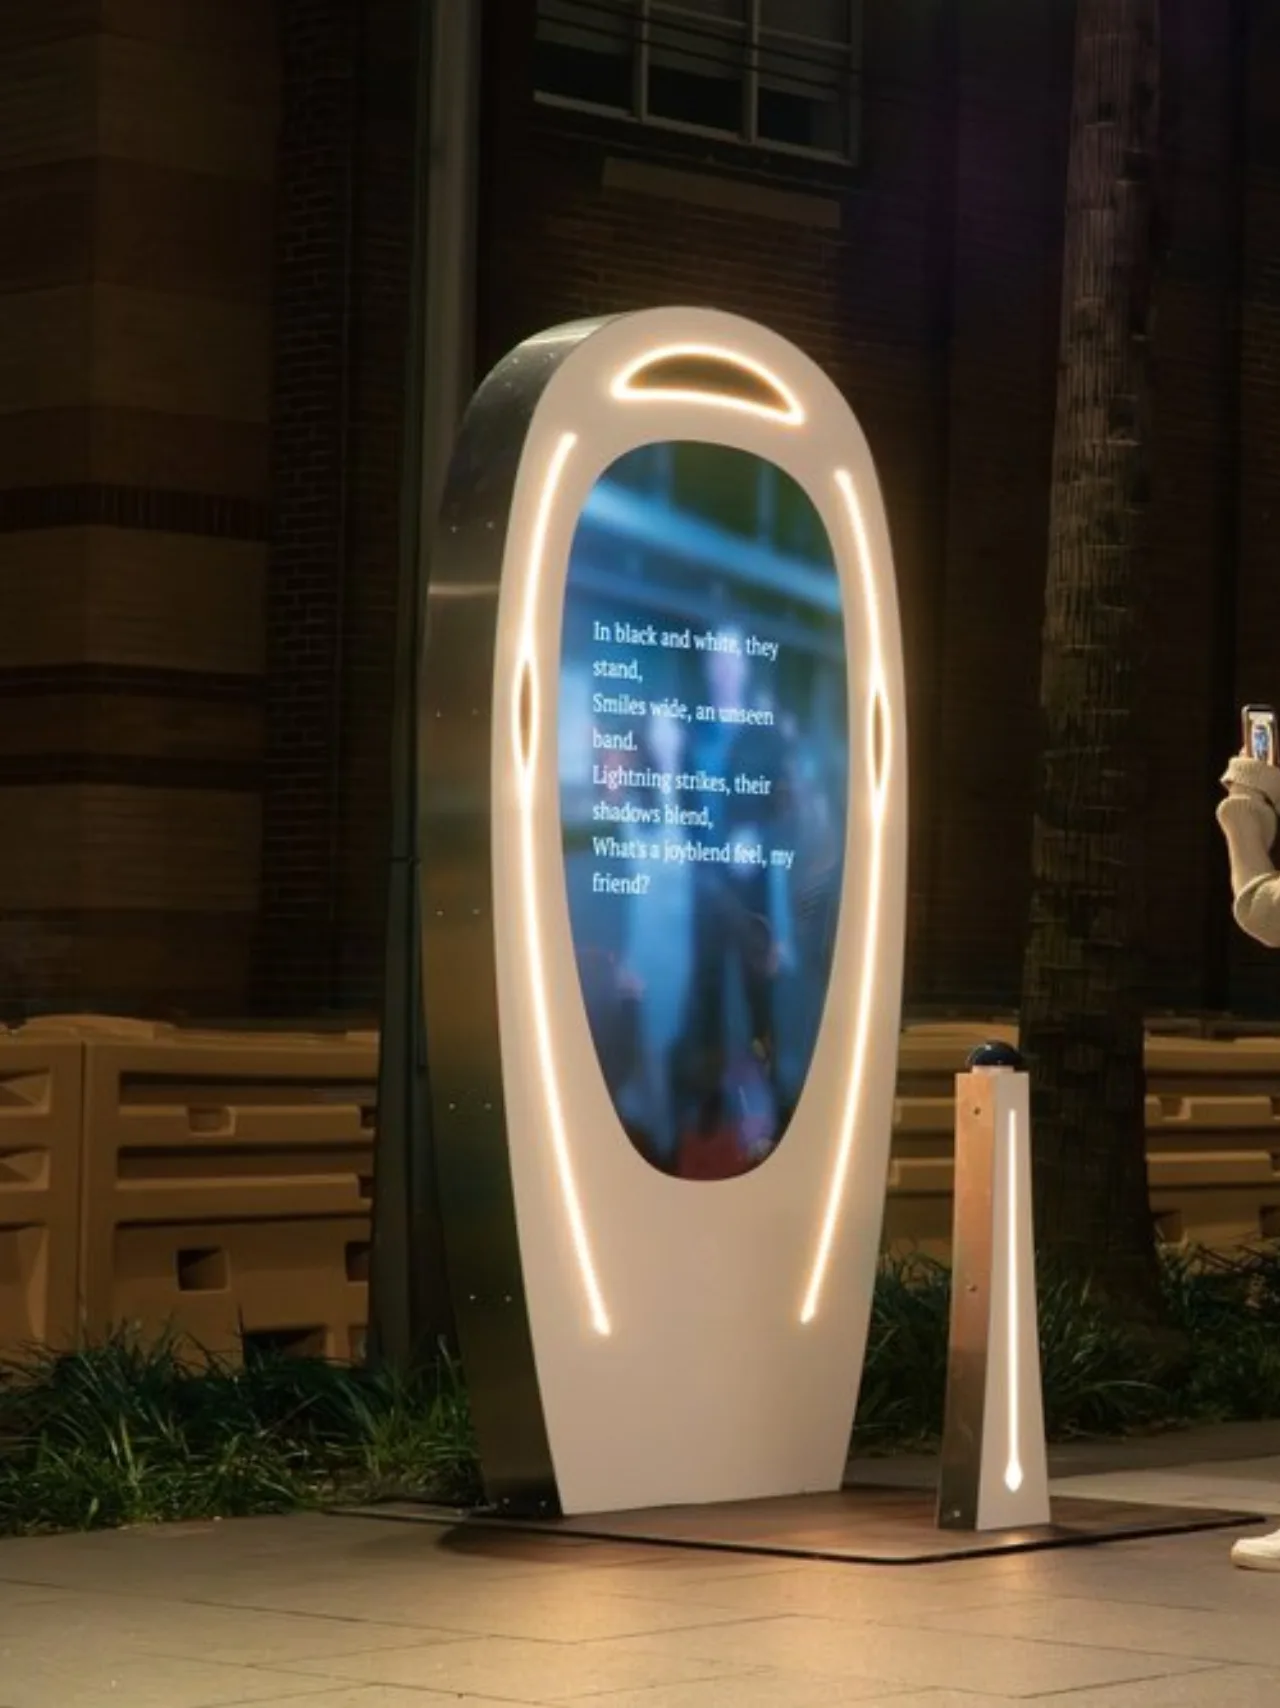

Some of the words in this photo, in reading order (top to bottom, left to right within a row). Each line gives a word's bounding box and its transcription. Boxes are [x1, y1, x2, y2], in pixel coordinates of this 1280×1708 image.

[593, 621, 611, 641] In
[614, 622, 657, 646] black
[661, 629, 690, 649] and
[693, 632, 742, 658] white,
[746, 636, 779, 661] they
[593, 659, 643, 682] stand,
[593, 693, 646, 715] Smiles
[650, 698, 692, 722] wide,
[696, 705, 715, 721] an
[719, 708, 774, 725] unseen
[593, 728, 637, 750] band.
[593, 765, 672, 793] Lightning
[675, 770, 730, 795] strikes,
[734, 773, 771, 795] their
[593, 801, 660, 822] shadows
[665, 805, 714, 829] blend,
[650, 845, 660, 859] a
[664, 841, 730, 867] joyblend
[734, 843, 767, 868] feel,
[771, 850, 795, 869] my
[593, 873, 650, 895] friend?
